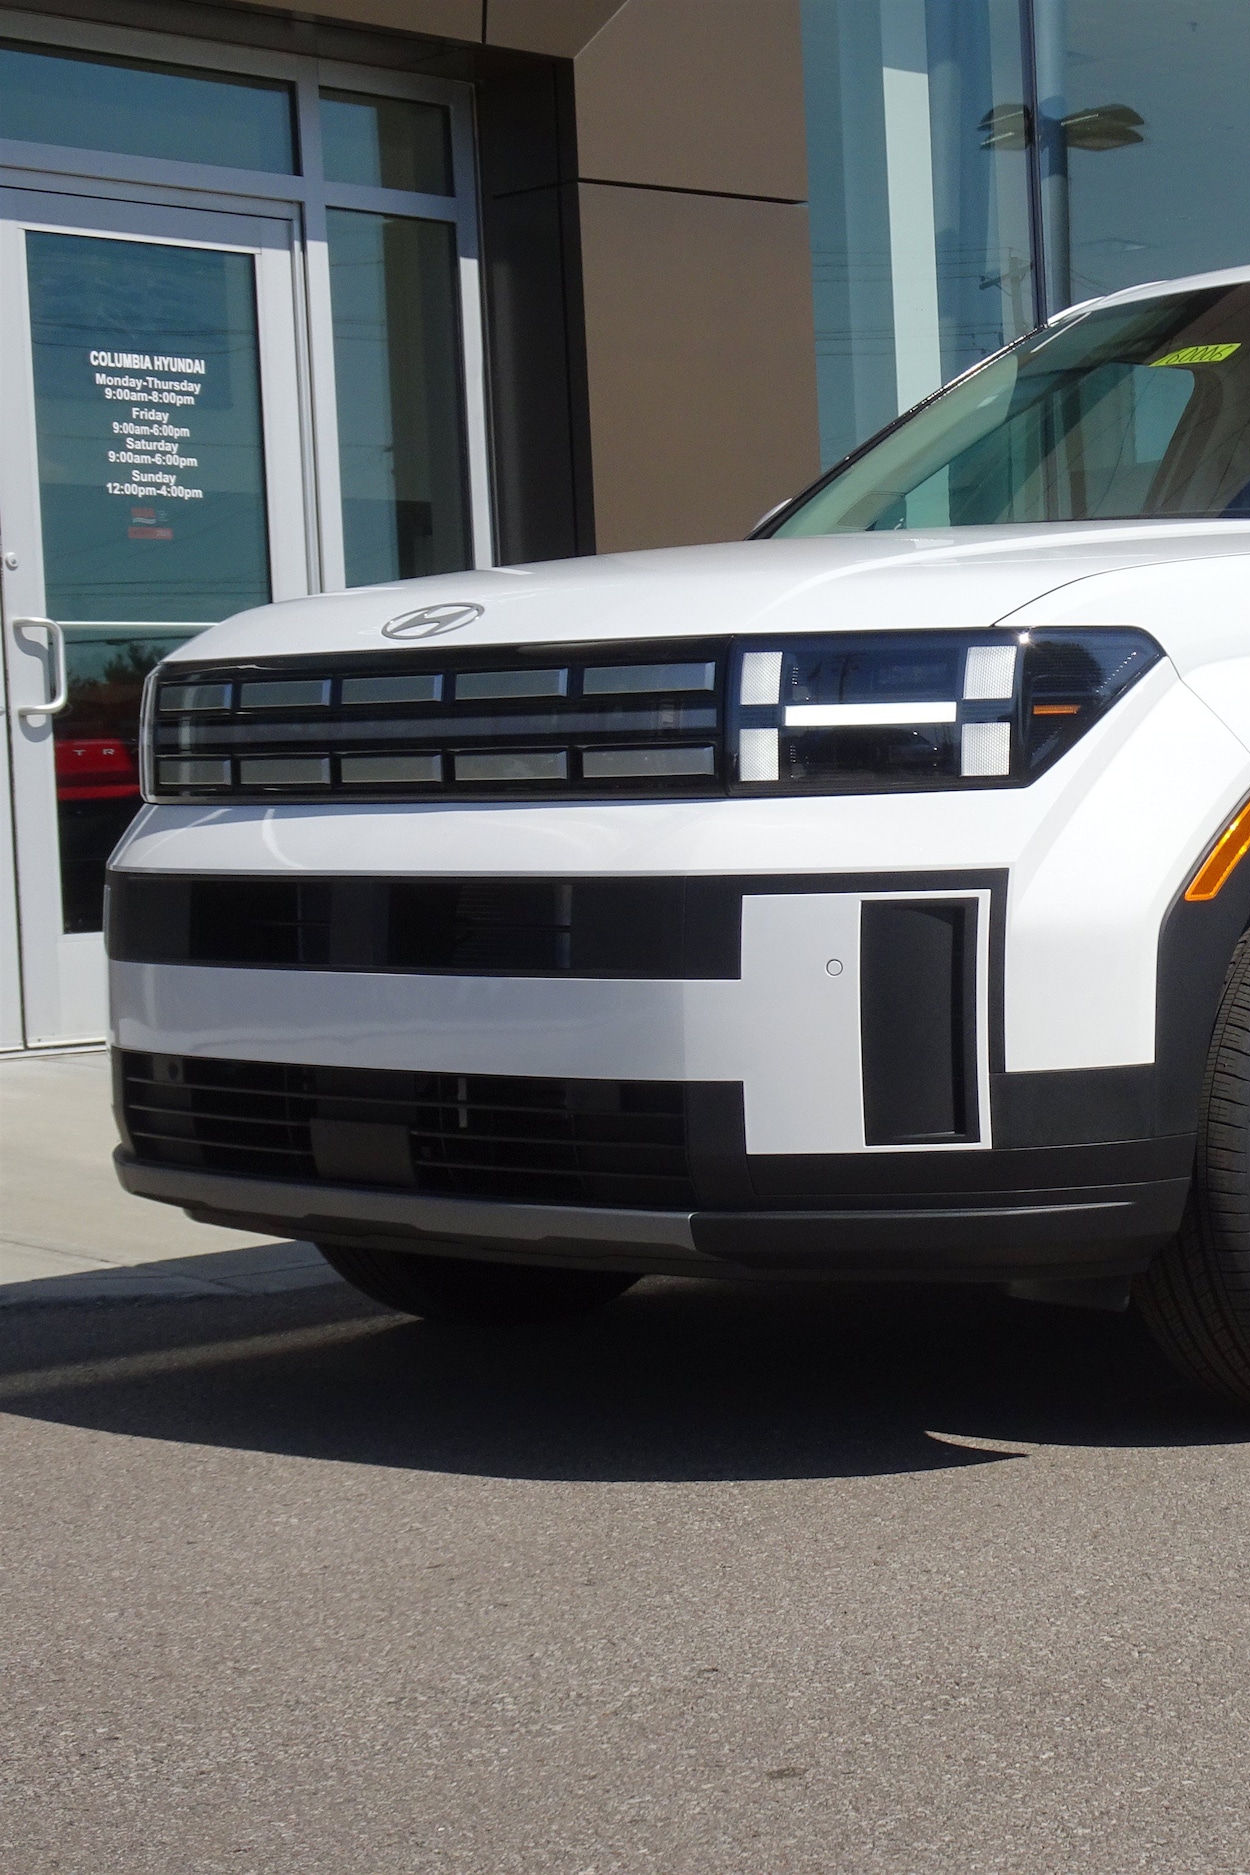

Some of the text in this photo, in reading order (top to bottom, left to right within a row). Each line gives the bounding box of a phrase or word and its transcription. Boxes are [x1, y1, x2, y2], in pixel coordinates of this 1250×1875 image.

[90, 351, 205, 374] COLUMBIA HYUNDAI
[95, 373, 201, 394] Monday-Thursday
[105, 388, 195, 406] 9:00am-8:00pm
[132, 408, 169, 423] Friday
[112, 422, 190, 438] 9:00am-6:00pm
[126, 438, 178, 454] Saturday
[108, 451, 198, 468] 9:00am-6:00pm
[132, 470, 176, 485] Sunday
[106, 483, 203, 500] 12:00pm-4:00pm
